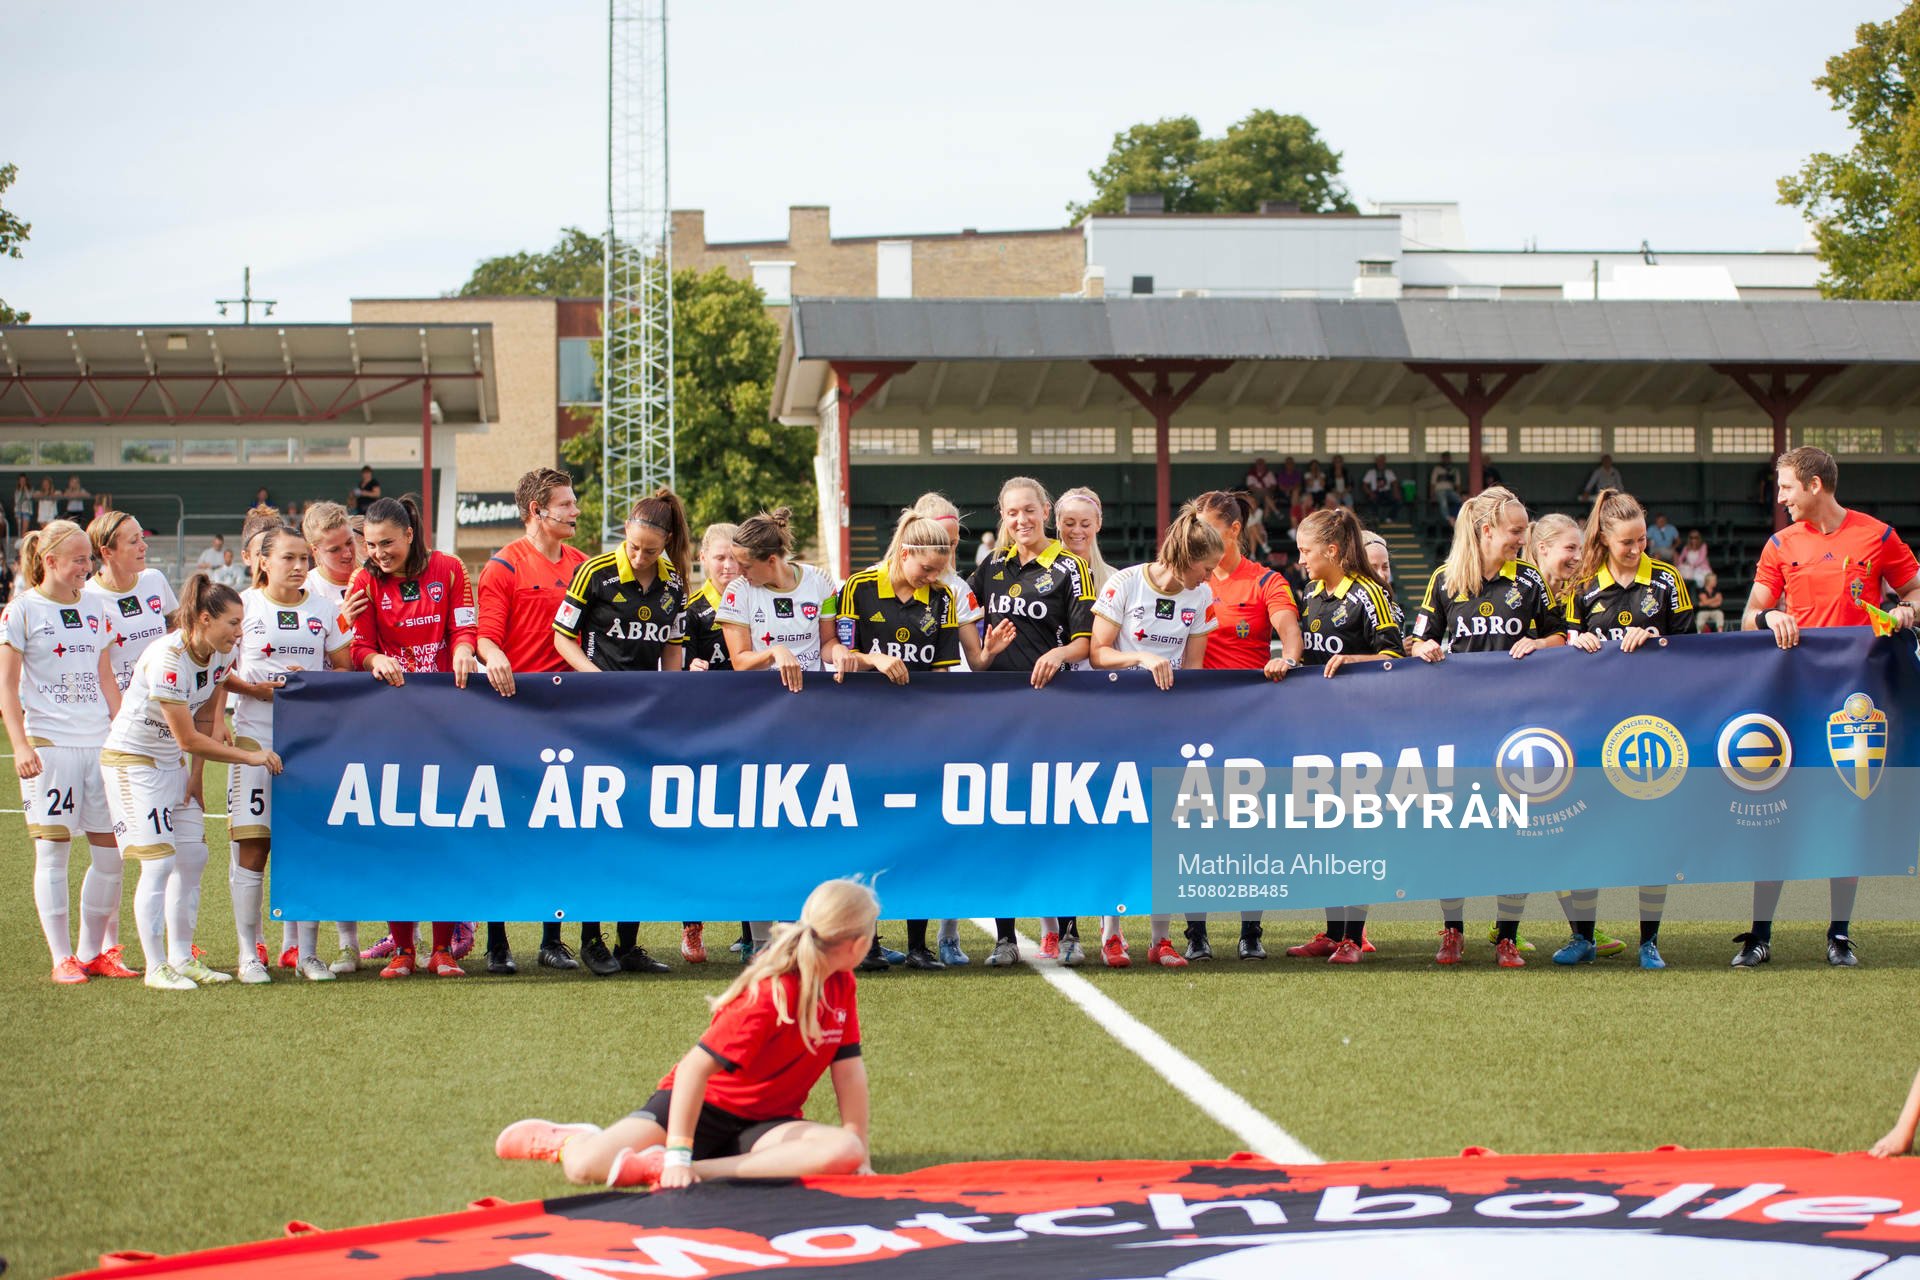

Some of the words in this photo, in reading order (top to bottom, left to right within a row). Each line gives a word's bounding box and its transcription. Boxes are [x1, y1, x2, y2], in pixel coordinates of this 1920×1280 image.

[606, 618, 671, 643] ÅBRO
[1456, 616, 1522, 638] ÅBRO
[1595, 626, 1660, 642] ÅBO
[1303, 632, 1344, 654] BRO
[1844, 724, 1877, 734] SvFF
[327, 763, 506, 828] ALLA
[528, 748, 626, 828] ÄR
[650, 764, 858, 828] OLIKA
[942, 762, 1149, 824] OLIKA
[1171, 744, 1266, 822] ÄR
[1292, 744, 1456, 820] BRA!
[46, 786, 75, 816] 24
[250, 788, 265, 816] 5
[1730, 799, 1788, 816] ELITETTAN
[1736, 818, 1762, 826] SEDAN
[508, 1184, 1920, 1280] Matchbolle
